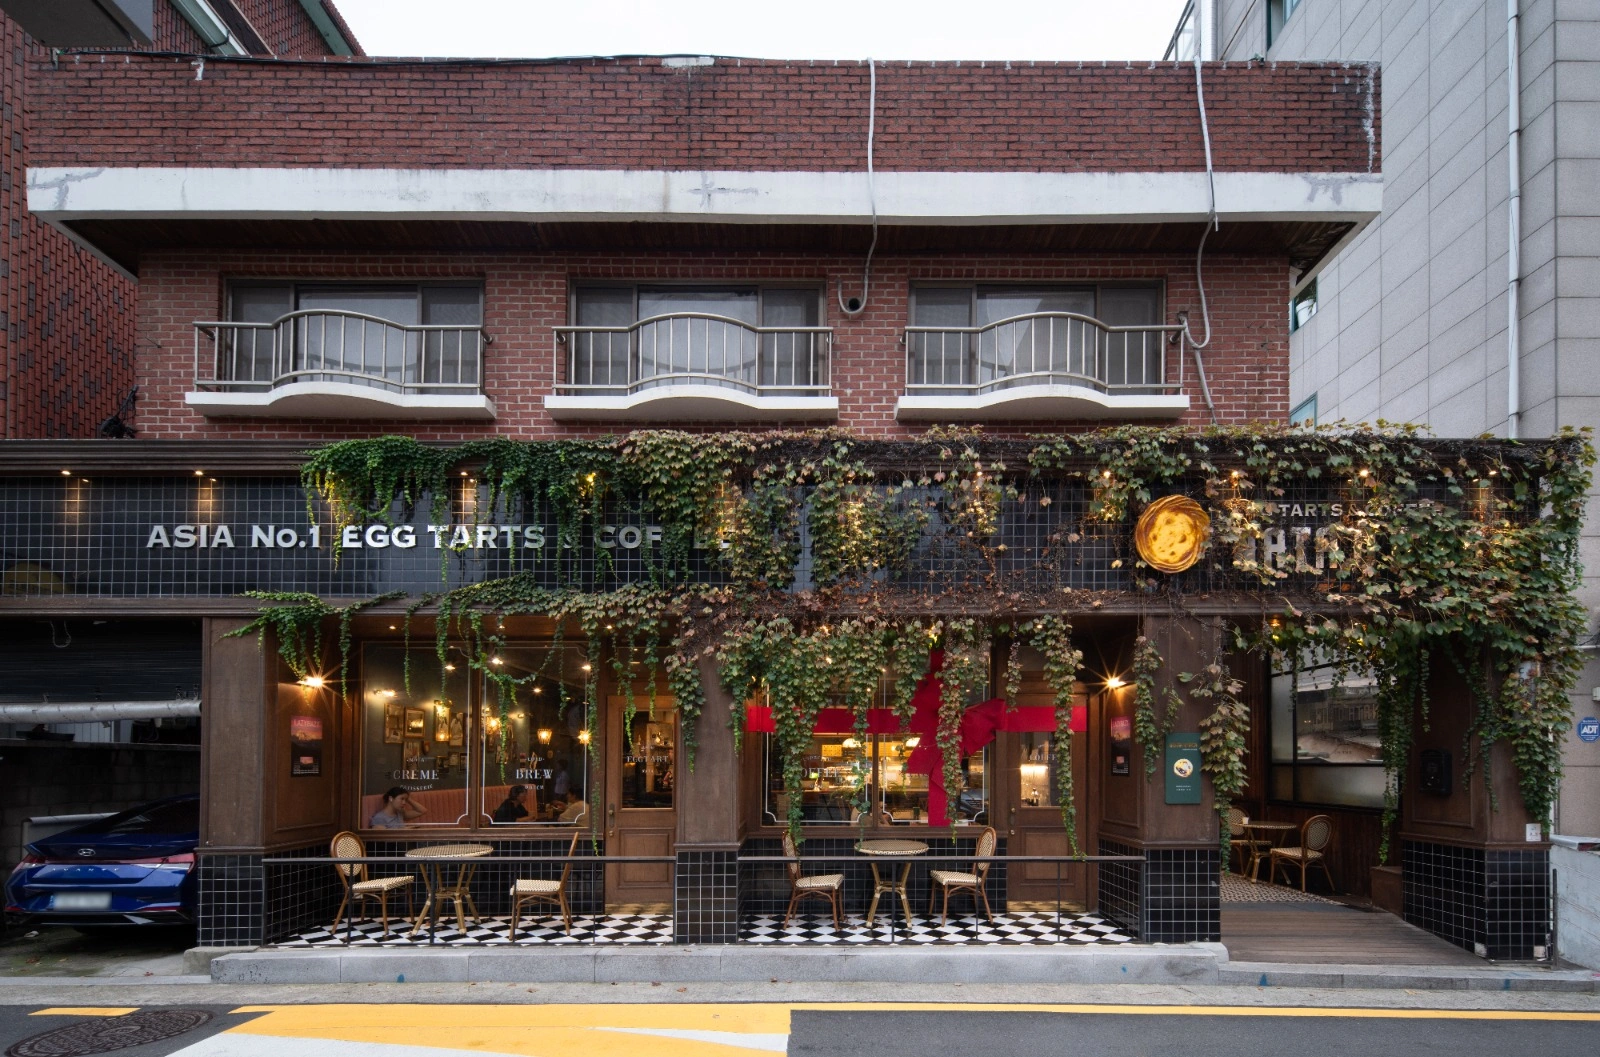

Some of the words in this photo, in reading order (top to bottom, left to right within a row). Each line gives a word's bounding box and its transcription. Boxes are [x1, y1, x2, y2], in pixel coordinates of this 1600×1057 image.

[146, 525, 235, 548] ASIA
[251, 525, 320, 548] No.1
[342, 525, 416, 549] EGG
[428, 525, 546, 549] TARTS
[1581, 725, 1598, 735] ADT
[516, 769, 553, 779] BREW
